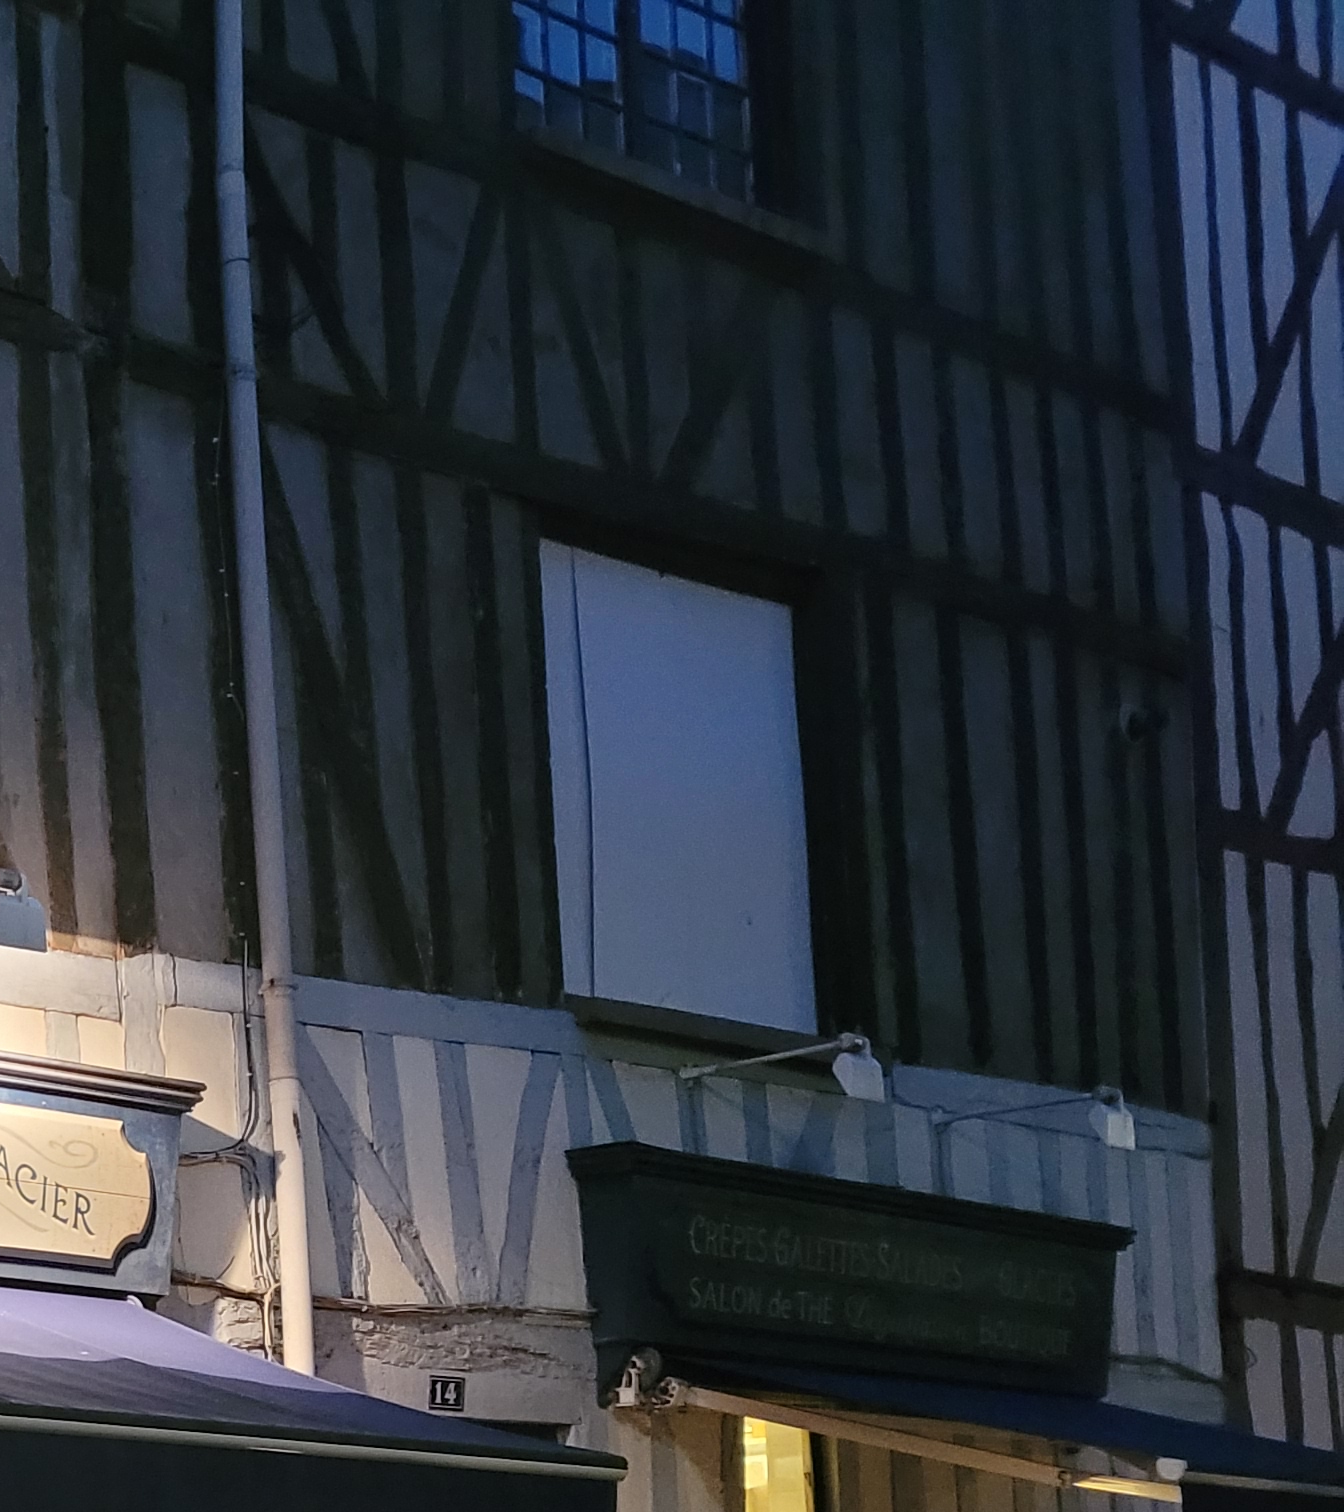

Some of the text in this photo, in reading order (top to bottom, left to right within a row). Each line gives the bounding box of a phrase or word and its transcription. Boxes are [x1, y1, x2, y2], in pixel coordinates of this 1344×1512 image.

[688, 1277, 762, 1316] SALON
[768, 1289, 793, 1320] de
[434, 1382, 457, 1405] 14
